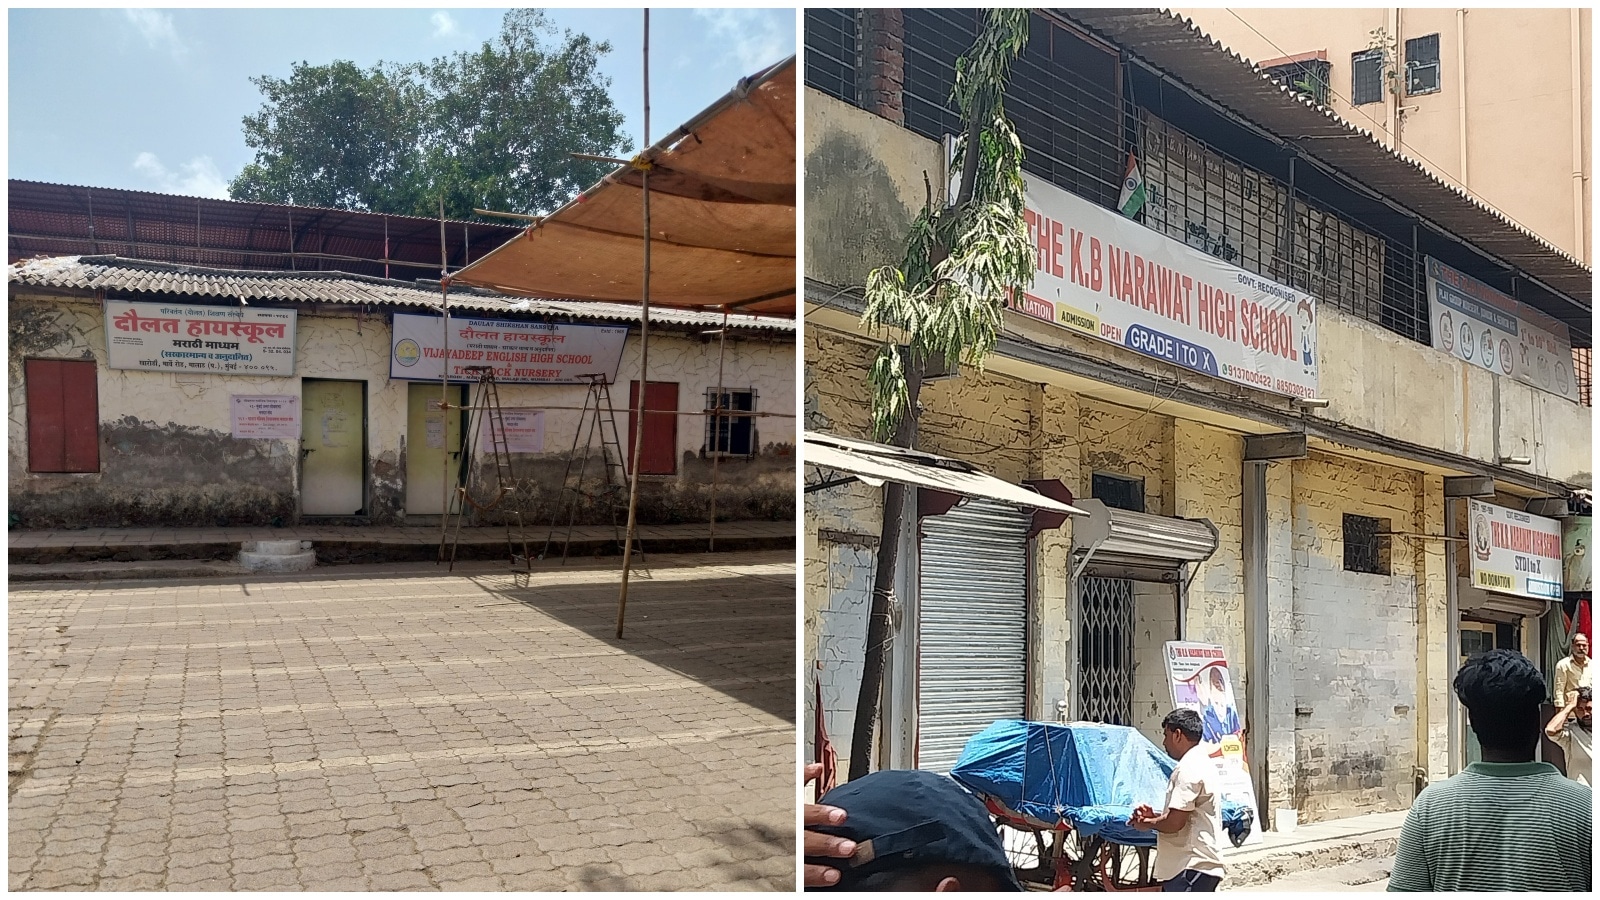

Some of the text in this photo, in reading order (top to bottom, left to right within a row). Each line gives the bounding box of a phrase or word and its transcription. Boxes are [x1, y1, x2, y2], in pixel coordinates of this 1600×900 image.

[1024, 208, 1297, 362] THE K.B NARAWAT HIGH SCHOOL
[1258, 283, 1296, 303] RECOGNISED
[113, 308, 286, 344] दौलत हायस्कूल
[1017, 294, 1051, 321] NATION
[1061, 310, 1095, 331] ADMISSION
[1100, 322, 1122, 342] OPEN
[1130, 327, 1173, 359] GRADE
[1182, 344, 1198, 366] TO
[1202, 352, 1210, 372] X
[172, 338, 240, 350] मराठी माध्यम
[459, 326, 566, 346] दौलत हायस्कूल
[161, 350, 207, 360] (सरकारमान्य
[423, 347, 593, 364] VIJAYADEEP ENGLISH HIGH SCHOOL
[225, 361, 237, 371] मुंबई
[484, 367, 510, 376] OCK
[514, 369, 562, 377] NURSERY
[1228, 365, 1272, 388] 9137000422
[1277, 378, 1315, 399] 8850302127
[1515, 555, 1527, 572] STD
[1530, 560, 1536, 574] to
[1536, 560, 1541, 574] X
[1480, 572, 1511, 588] NO DONATION
